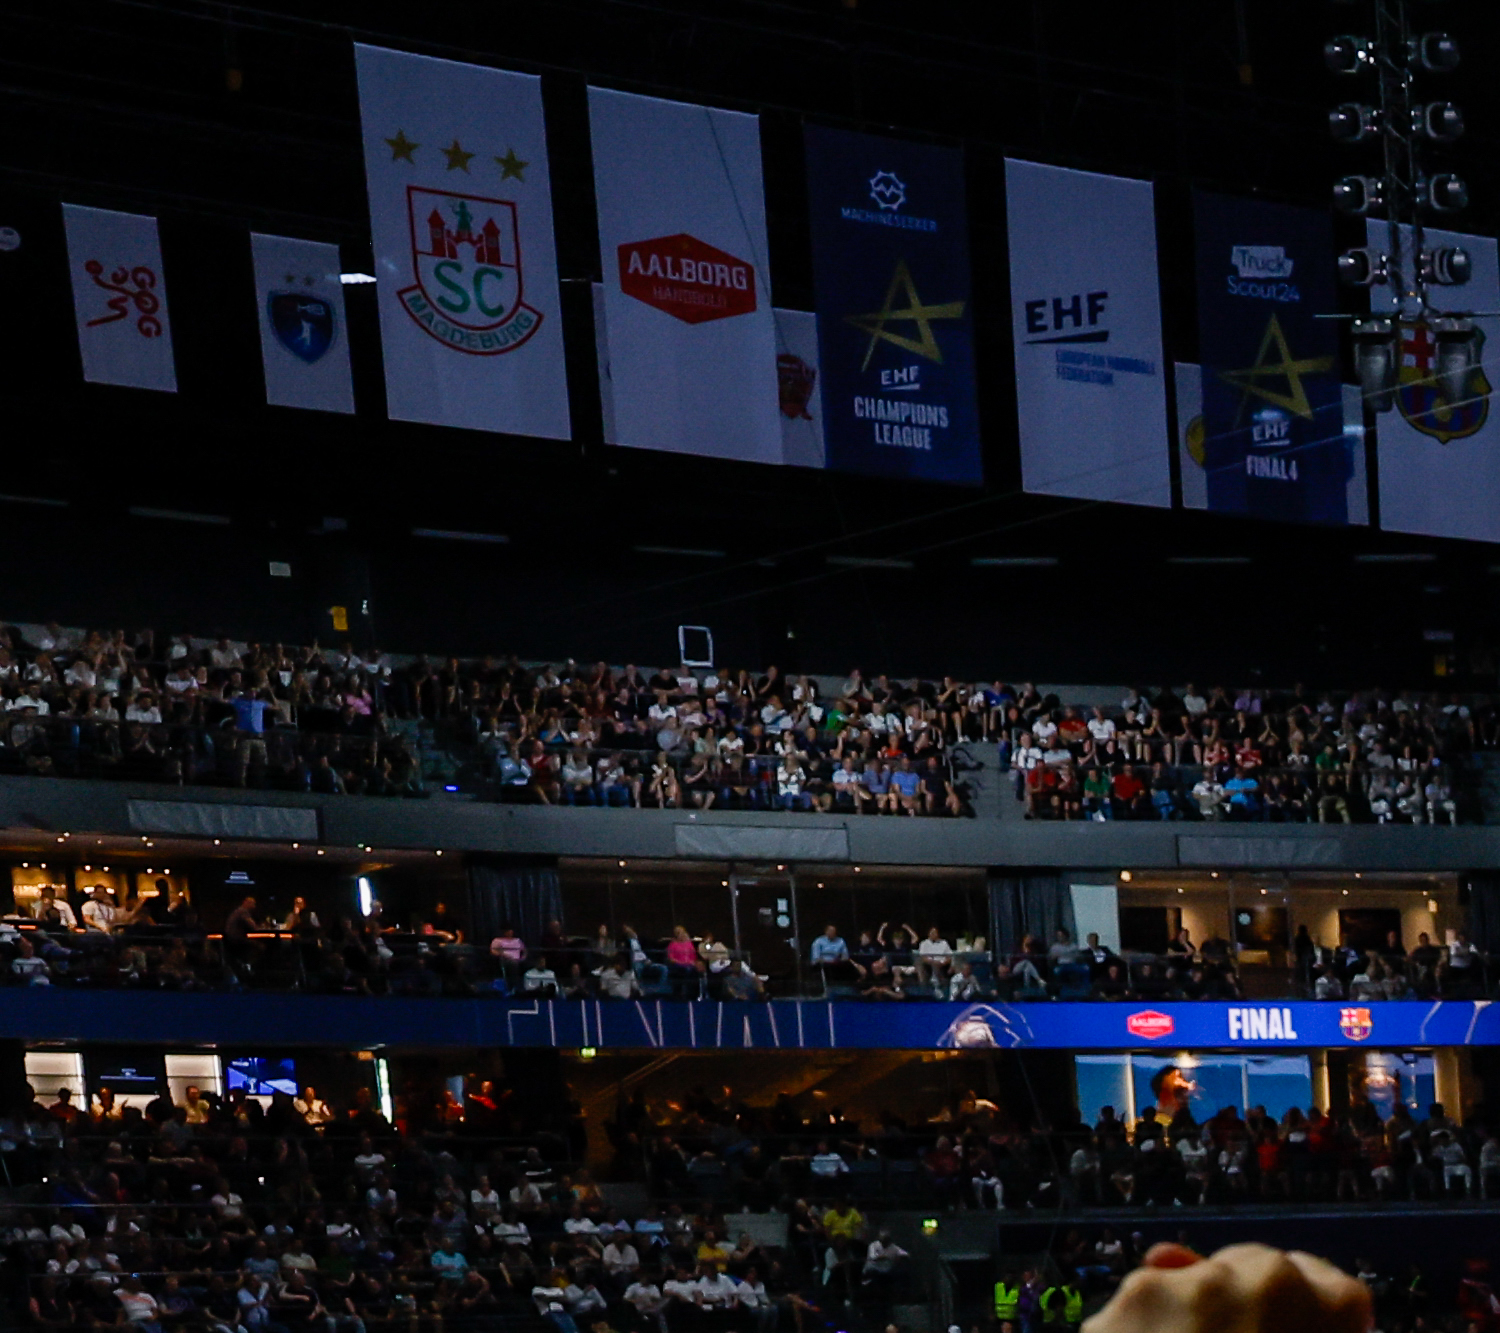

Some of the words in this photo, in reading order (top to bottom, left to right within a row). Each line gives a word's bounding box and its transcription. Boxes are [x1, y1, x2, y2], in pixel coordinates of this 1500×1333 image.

[432, 260, 504, 319] SC
[627, 250, 749, 292] AALBORG
[409, 292, 535, 350] MAGDEBURG
[1025, 291, 1109, 333] EHF
[880, 365, 920, 387] EHF
[853, 395, 949, 428] CHAMPIONS
[873, 422, 932, 450] LEAGUE
[1228, 1007, 1298, 1040] FINAL
